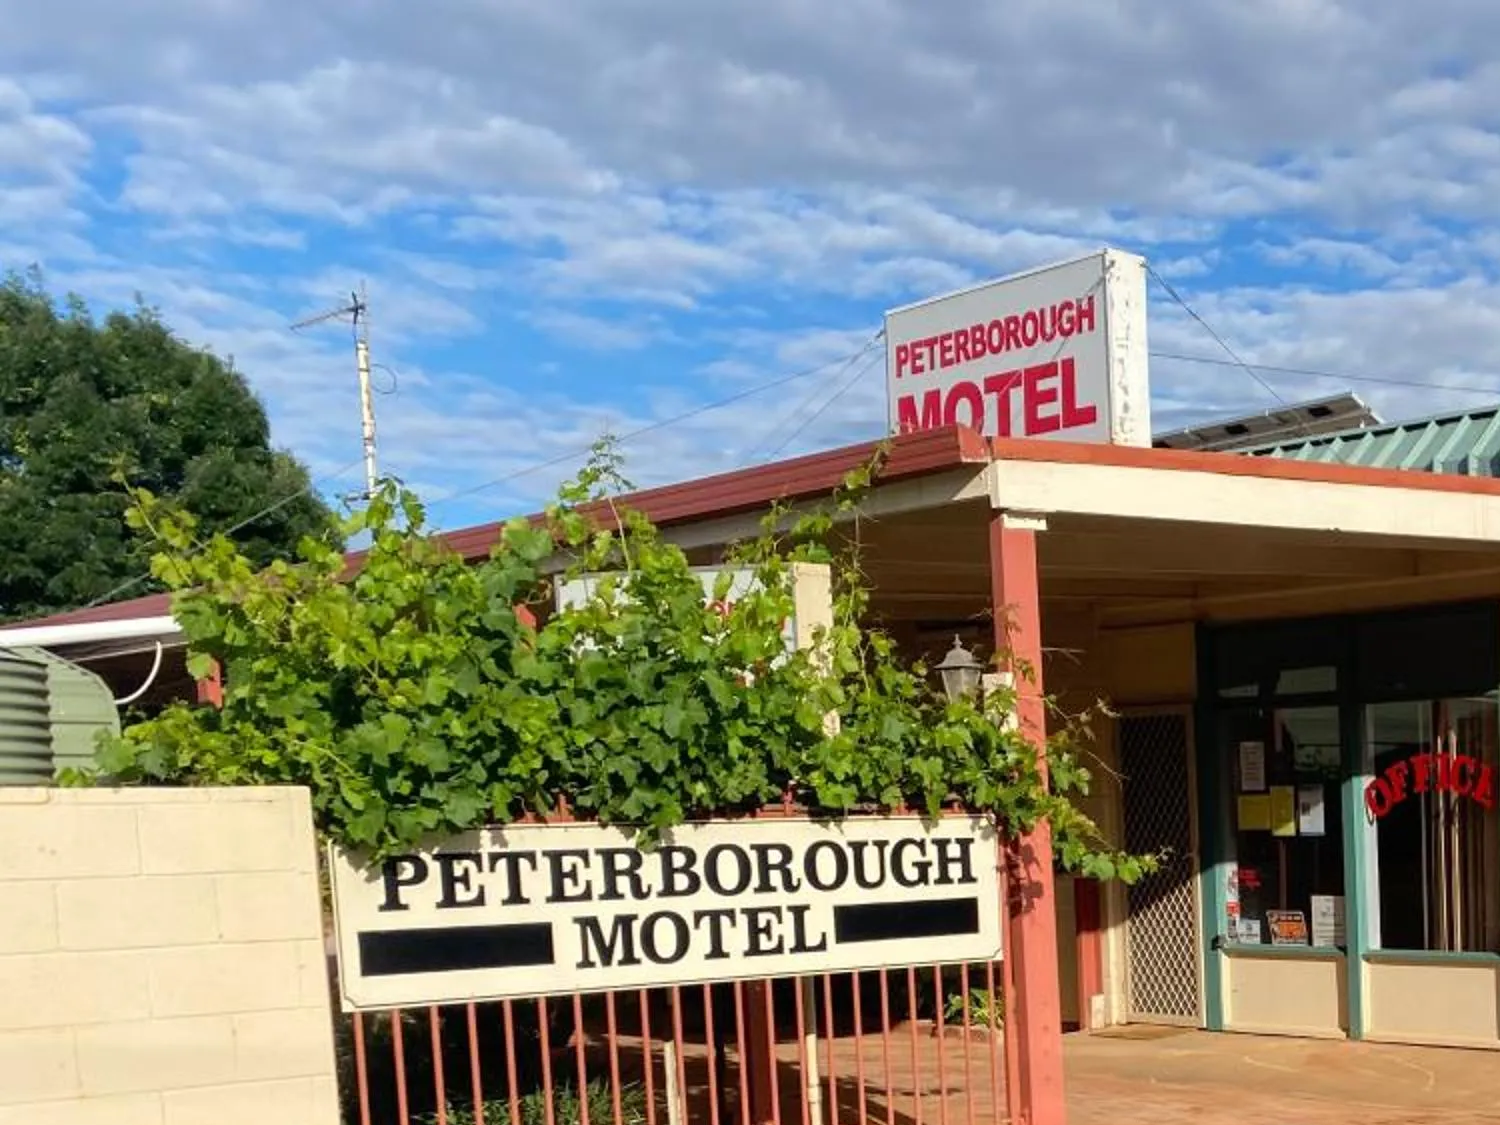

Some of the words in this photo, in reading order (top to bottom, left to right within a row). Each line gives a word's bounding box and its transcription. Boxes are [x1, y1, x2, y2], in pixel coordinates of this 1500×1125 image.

[895, 295, 1095, 379] PETERBOROUGH
[896, 357, 1098, 437] MOTEL
[1364, 752, 1497, 818] OFFICE
[378, 837, 978, 912] PETERBOROUGH
[573, 906, 827, 969] MOTEL
